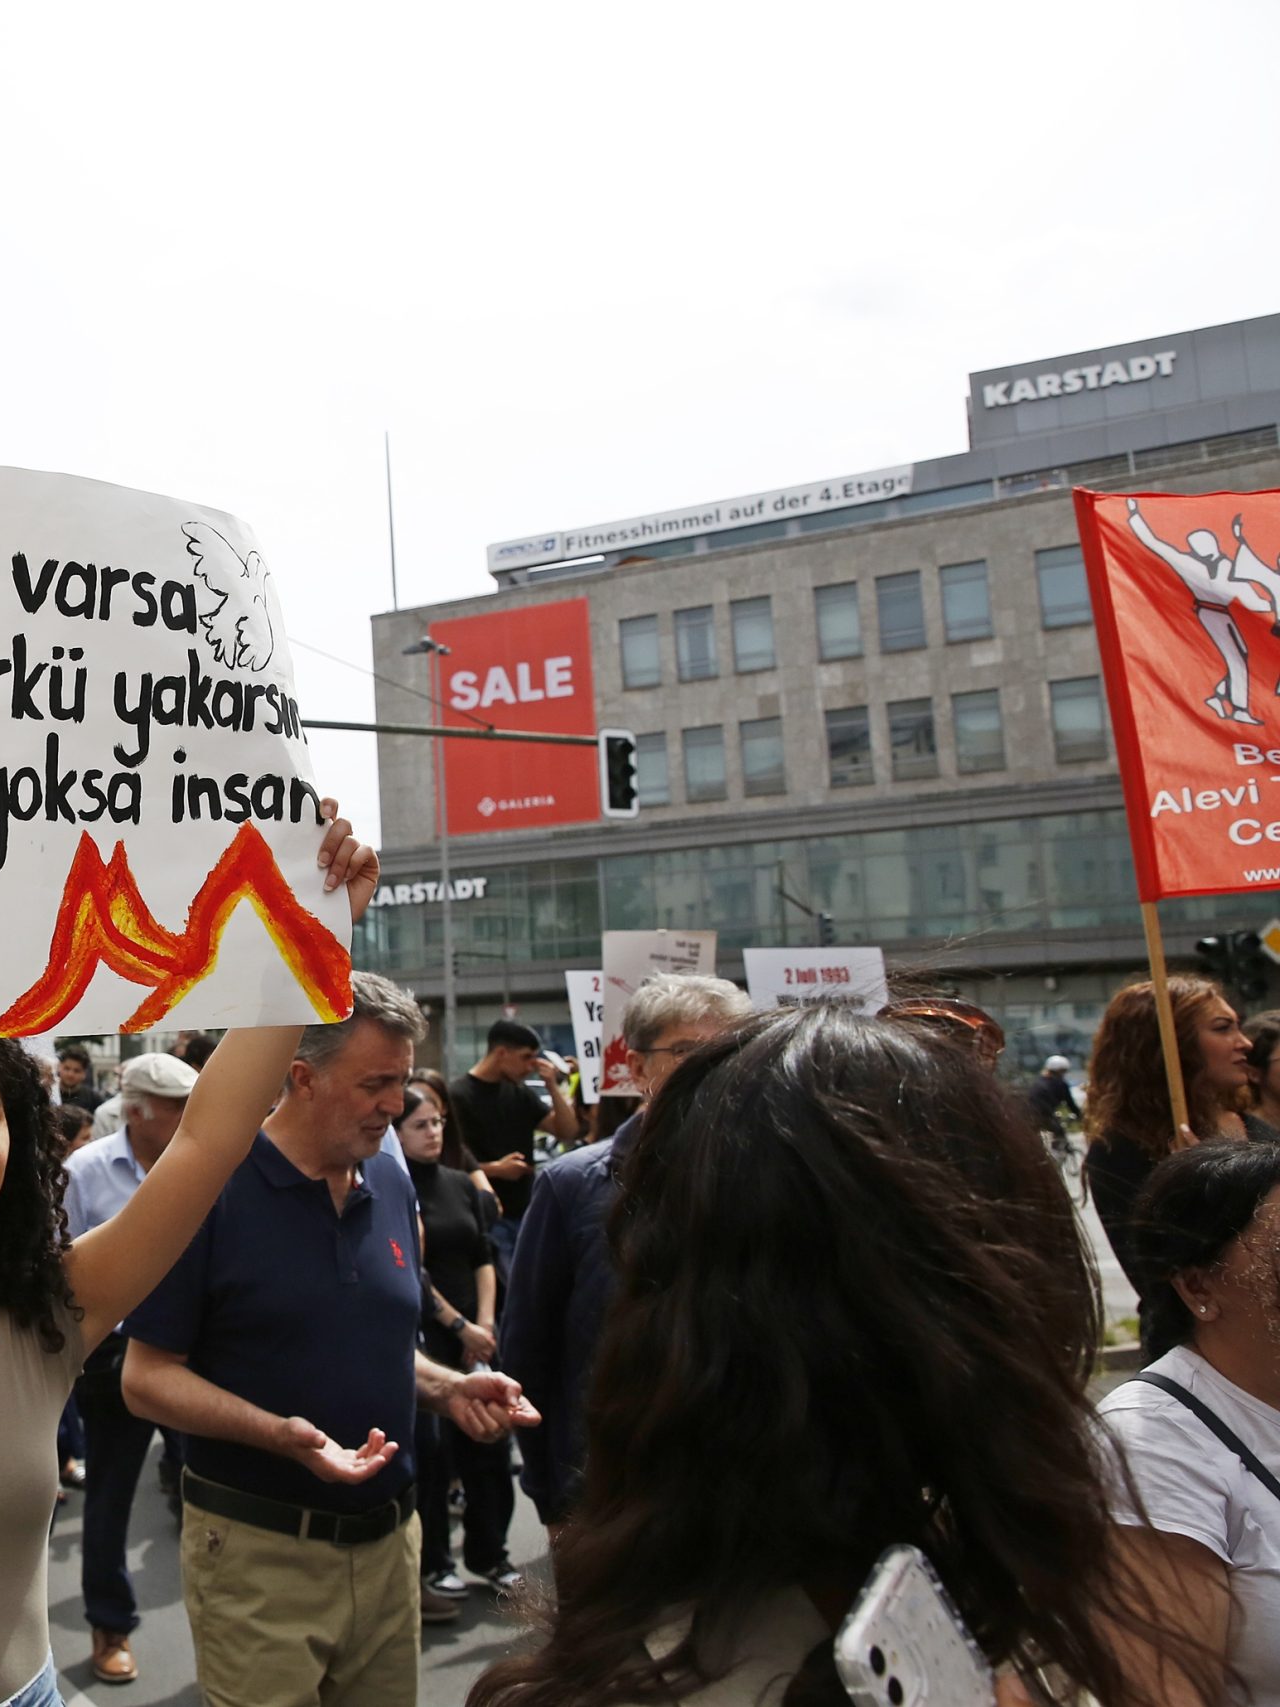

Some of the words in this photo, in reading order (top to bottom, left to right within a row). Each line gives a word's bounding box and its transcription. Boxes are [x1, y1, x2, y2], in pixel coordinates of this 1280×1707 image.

[983, 351, 1177, 408] KARSTADT
[566, 507, 720, 551] Fitnesshimmel
[729, 502, 766, 520] auf
[773, 494, 811, 512] der
[11, 551, 197, 634] varsa
[450, 656, 574, 710] SALE
[172, 746, 325, 825] insan
[1150, 778, 1260, 818] Alevi
[370, 877, 487, 906] ARSTADT
[592, 976, 600, 992] 2
[784, 967, 793, 984] 2
